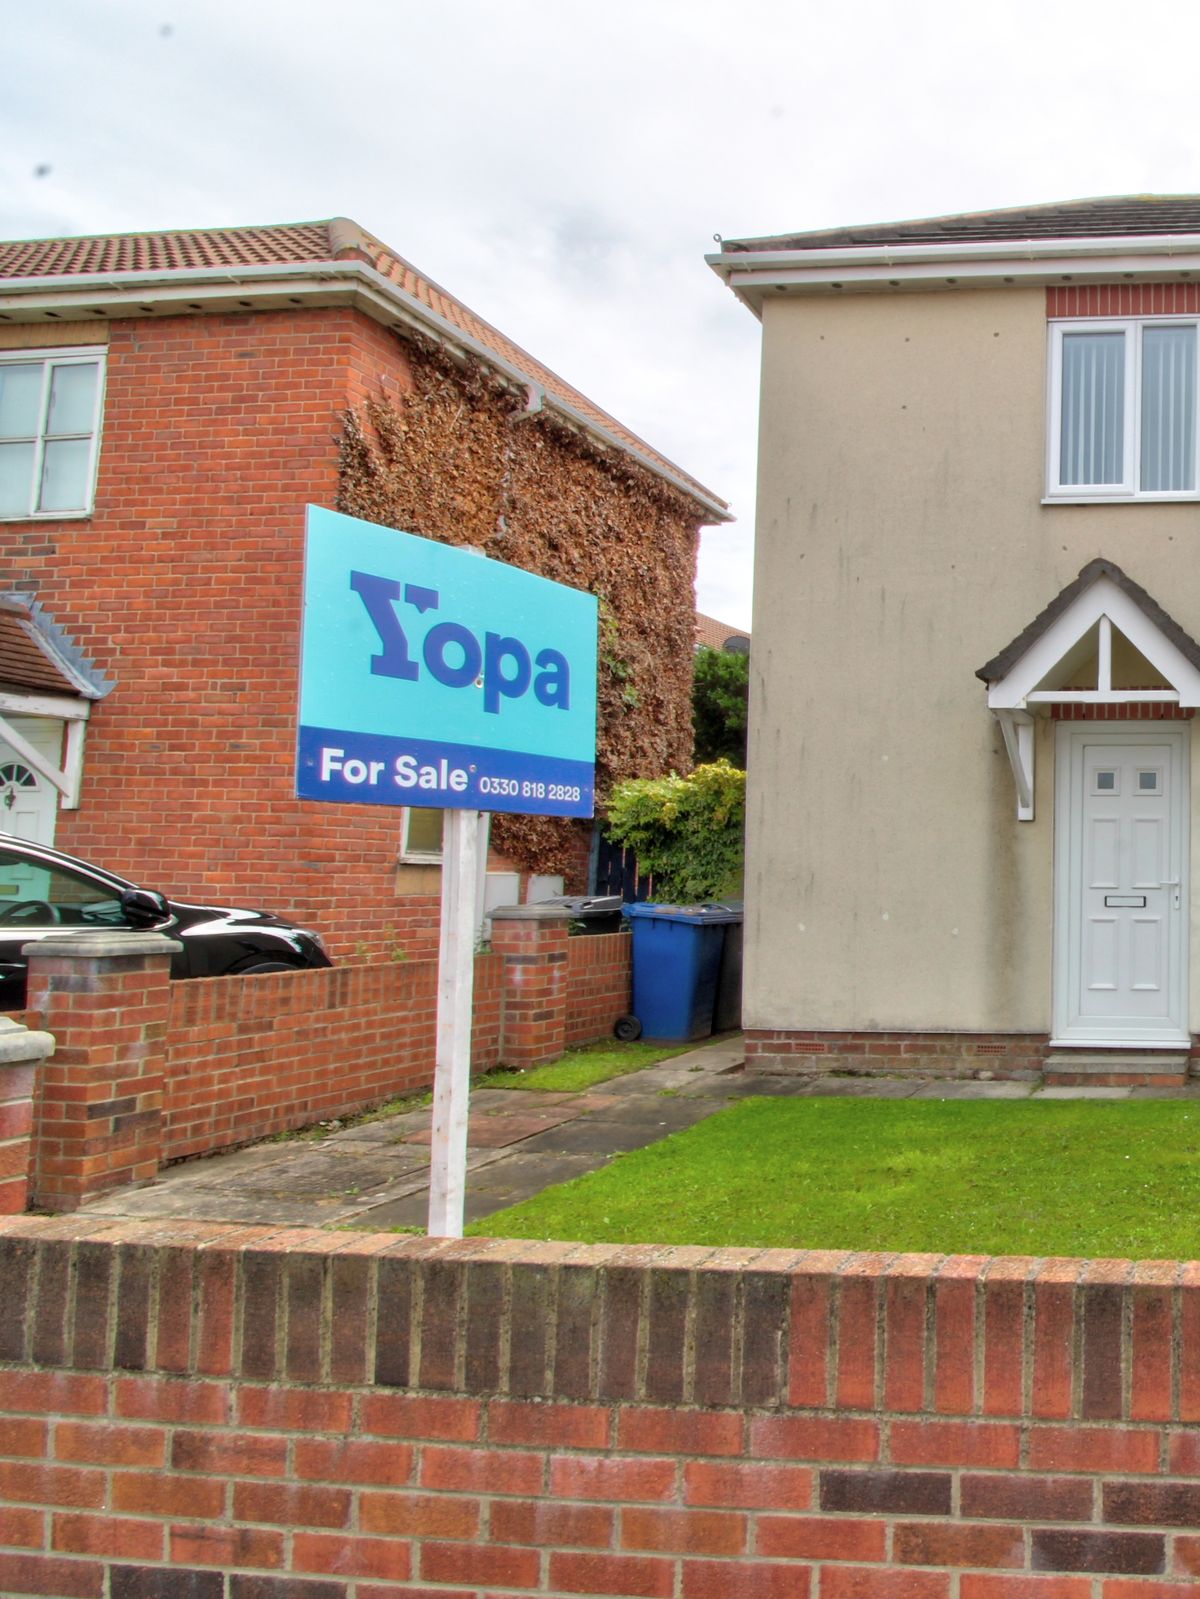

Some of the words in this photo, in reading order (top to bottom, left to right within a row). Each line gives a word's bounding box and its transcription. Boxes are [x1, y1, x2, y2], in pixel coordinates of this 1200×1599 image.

[350, 570, 570, 714] Yopa
[321, 748, 385, 785] For
[394, 755, 468, 791] Sale
[479, 777, 518, 797] 0330
[522, 780, 546, 799] 818
[548, 783, 581, 801] 2828
